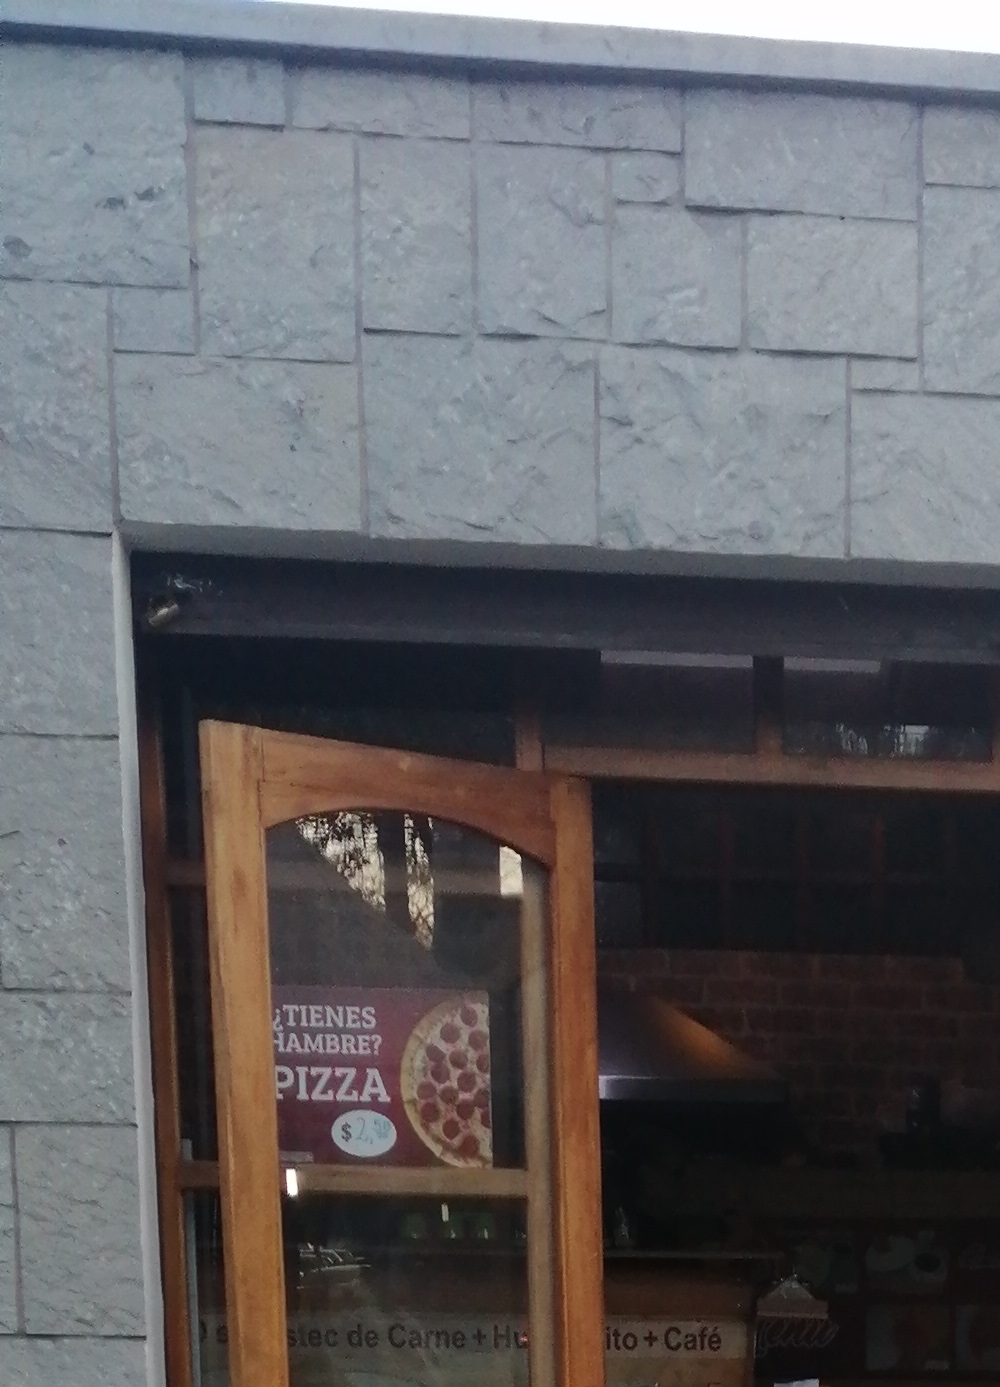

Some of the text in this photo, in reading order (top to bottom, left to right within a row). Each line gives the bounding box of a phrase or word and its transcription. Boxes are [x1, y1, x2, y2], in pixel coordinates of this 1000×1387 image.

[273, 1004, 377, 1031] ¿TIENES
[274, 1032, 382, 1056] HAMBRE?
[275, 1065, 391, 1103] PIZZA
[347, 1323, 379, 1349] de
[388, 1322, 466, 1350] Carne
[664, 1326, 722, 1352] Café
